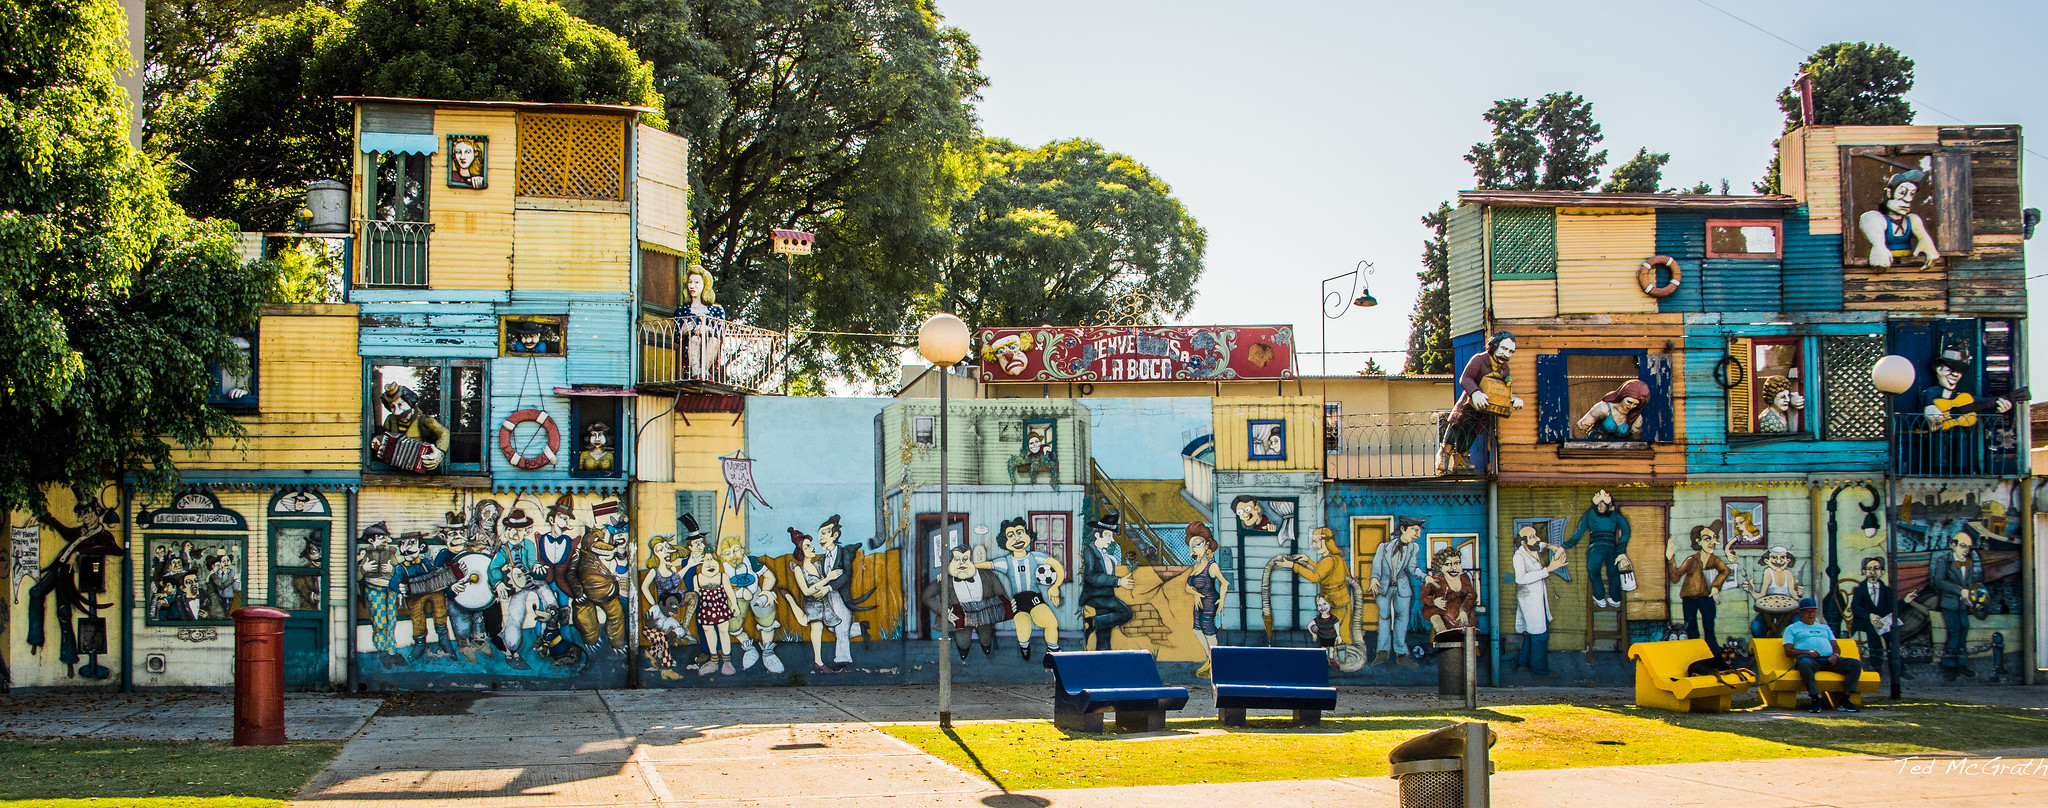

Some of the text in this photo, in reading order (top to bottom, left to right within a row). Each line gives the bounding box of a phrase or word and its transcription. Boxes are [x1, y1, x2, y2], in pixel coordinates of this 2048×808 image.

[1101, 358, 1173, 380] LA BOCA
[524, 456, 548, 469] BOCA
[178, 494, 213, 509] CANTINA
[157, 515, 165, 523] LA
[166, 514, 188, 523] CUEVA
[196, 514, 236, 524] ZINGARELLA
[1017, 565, 1026, 573] 10
[1031, 596, 1041, 606] 10
